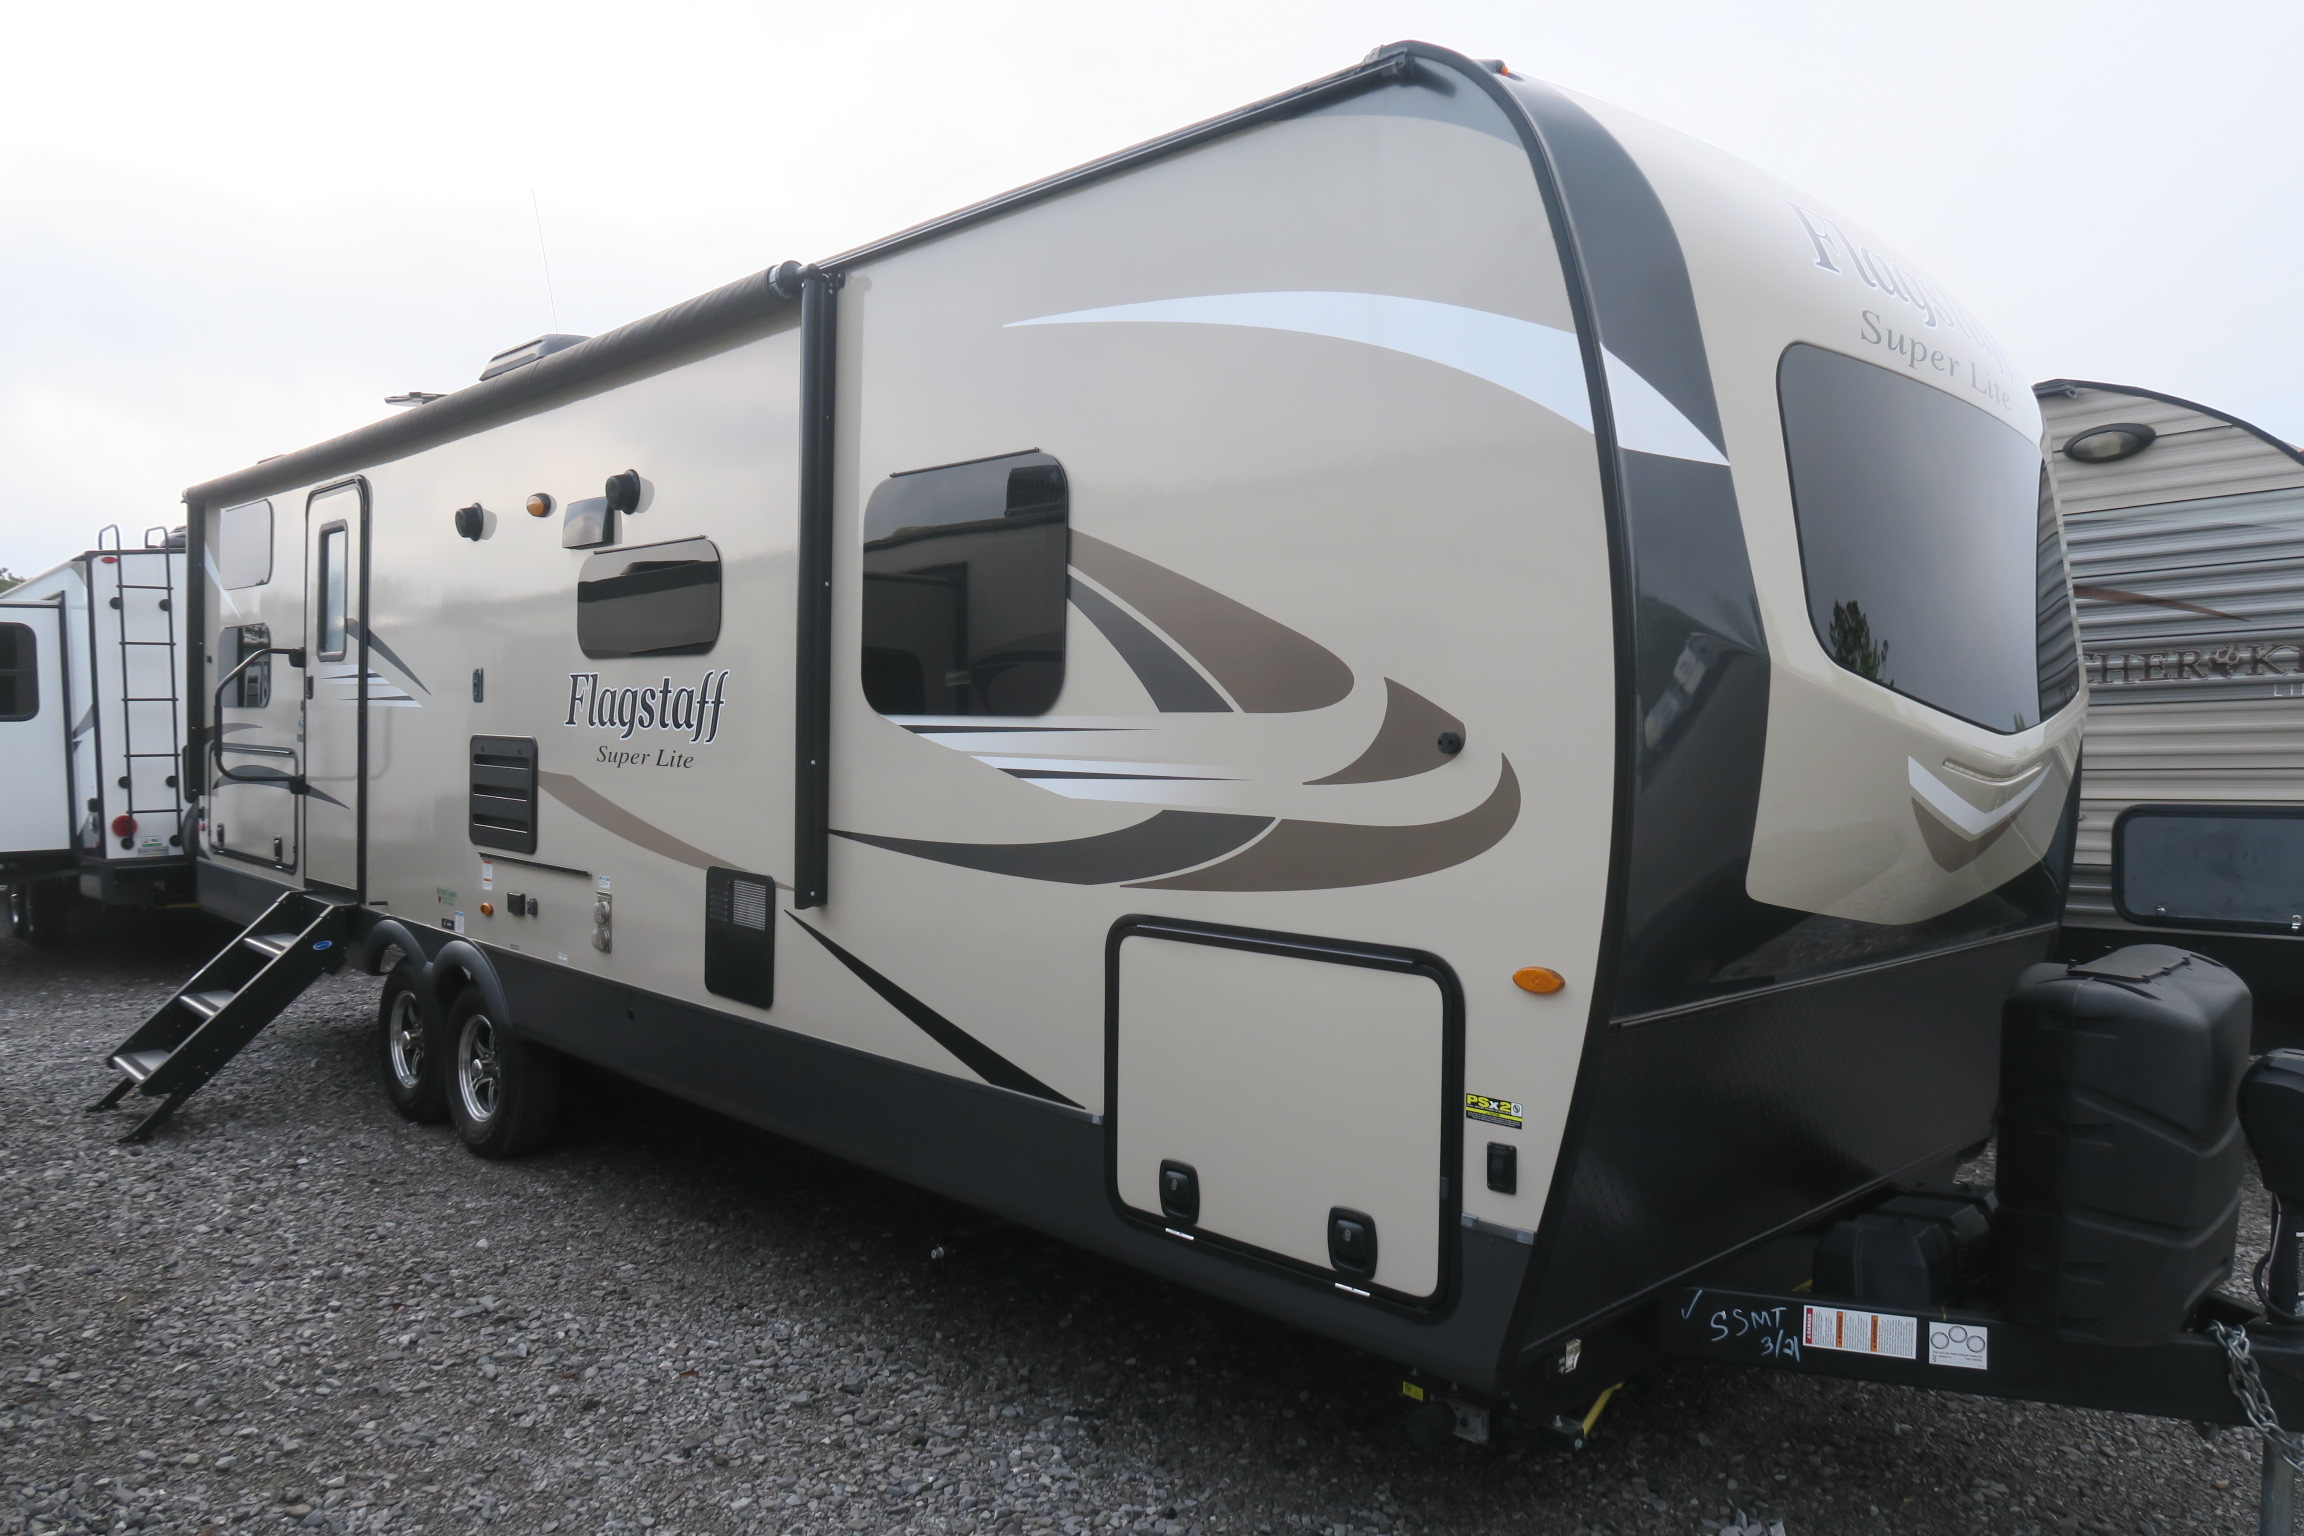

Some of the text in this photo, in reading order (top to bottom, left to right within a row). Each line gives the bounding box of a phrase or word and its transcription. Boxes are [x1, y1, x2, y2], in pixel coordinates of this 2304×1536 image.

[1859, 309, 2013, 411] Super Lite
[565, 669, 730, 744] Flagstaff
[596, 745, 694, 769] Super Lite
[1710, 1306, 1788, 1342] SSMT
